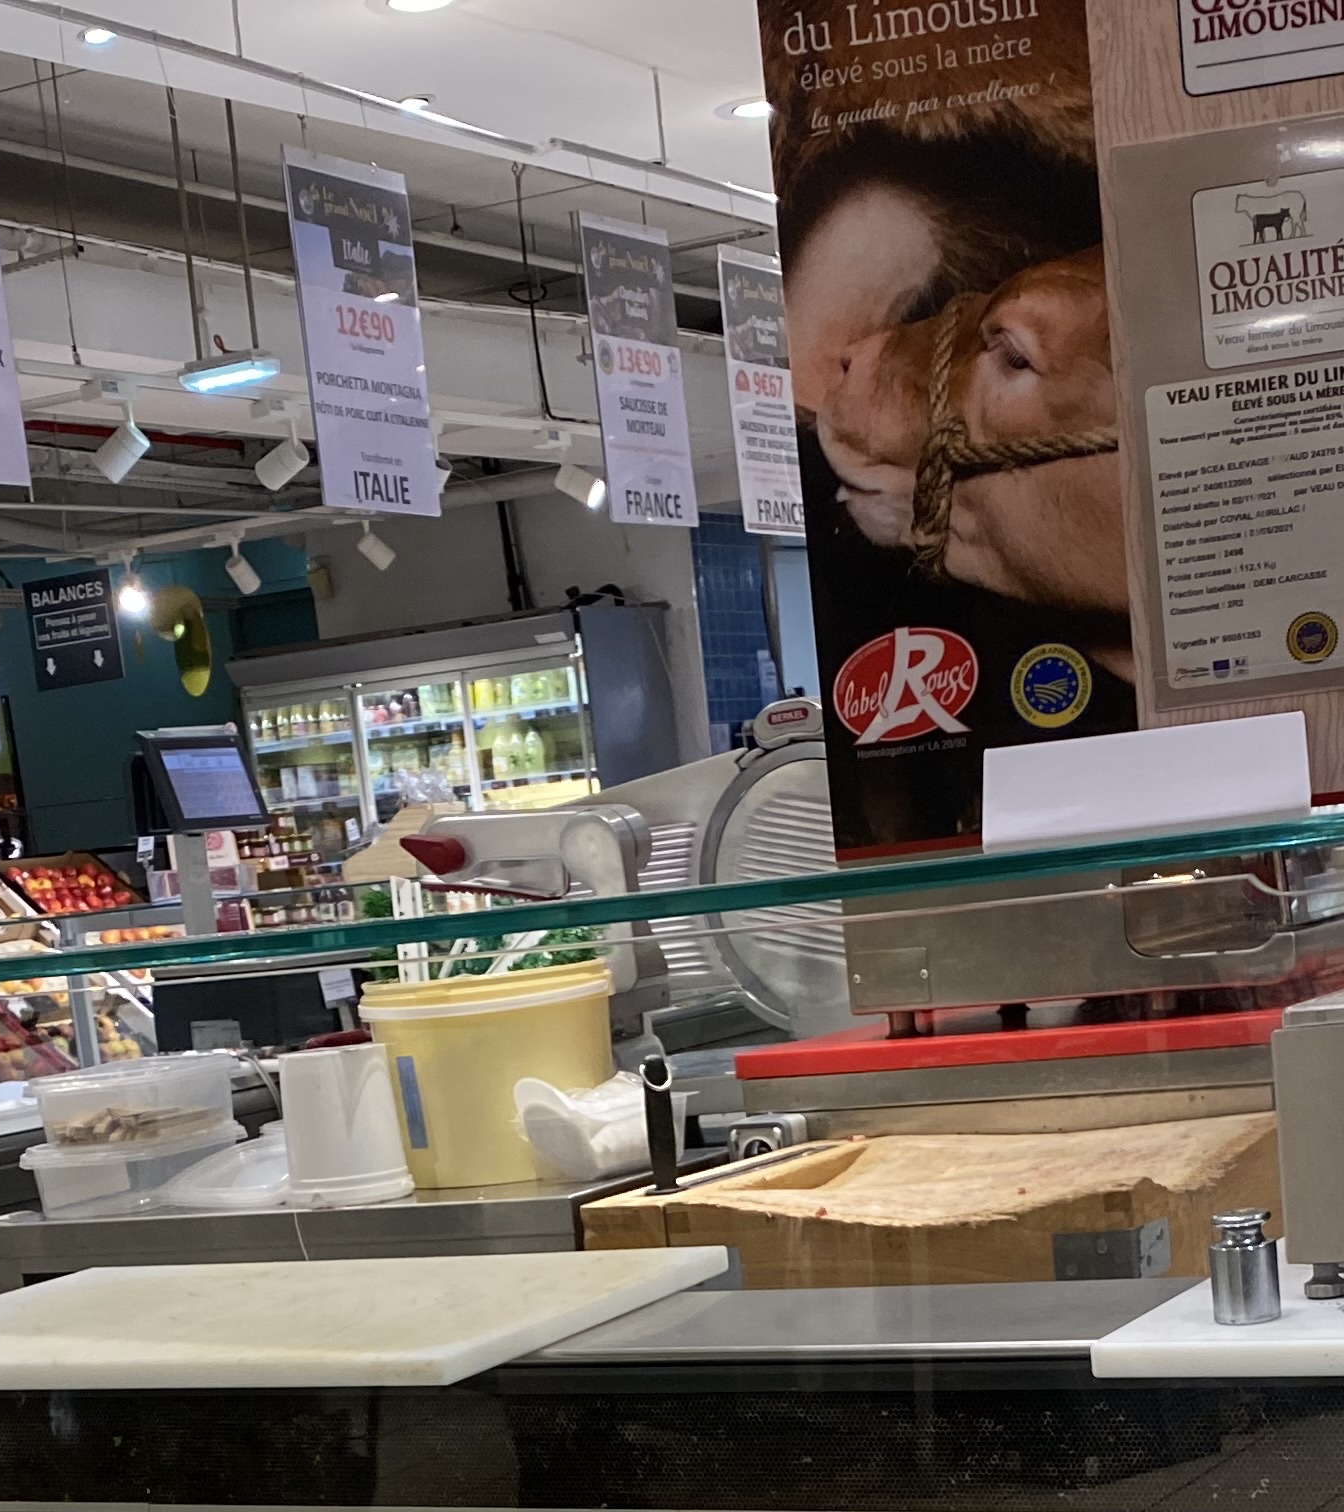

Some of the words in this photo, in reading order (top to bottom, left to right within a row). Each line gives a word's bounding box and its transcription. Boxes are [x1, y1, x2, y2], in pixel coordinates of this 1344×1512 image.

[783, 11, 832, 56] du
[800, 57, 863, 91] élevé
[872, 51, 928, 80] sous
[935, 43, 958, 70] la
[967, 34, 1033, 65] mère
[810, 106, 831, 132] la
[905, 97, 940, 123] par
[336, 305, 395, 343] 12€90
[1216, 332, 1246, 346] Veau
[616, 346, 662, 377] 13€90
[316, 371, 369, 391] PORCHETTA
[753, 371, 783, 398] 9€67
[1166, 386, 1210, 405] VEAU
[1215, 374, 1289, 400] FERMIER
[1294, 369, 1319, 386] DU
[1266, 392, 1297, 406] SOUS
[1299, 390, 1313, 402] LA
[354, 471, 411, 504] ITALIE
[1310, 481, 1335, 493] VEAU
[625, 490, 682, 519] FRANCE
[1278, 569, 1328, 584] CARCASSE
[31, 581, 104, 608] BALANCES
[843, 671, 888, 720] label
[771, 710, 805, 723] BERKEL
